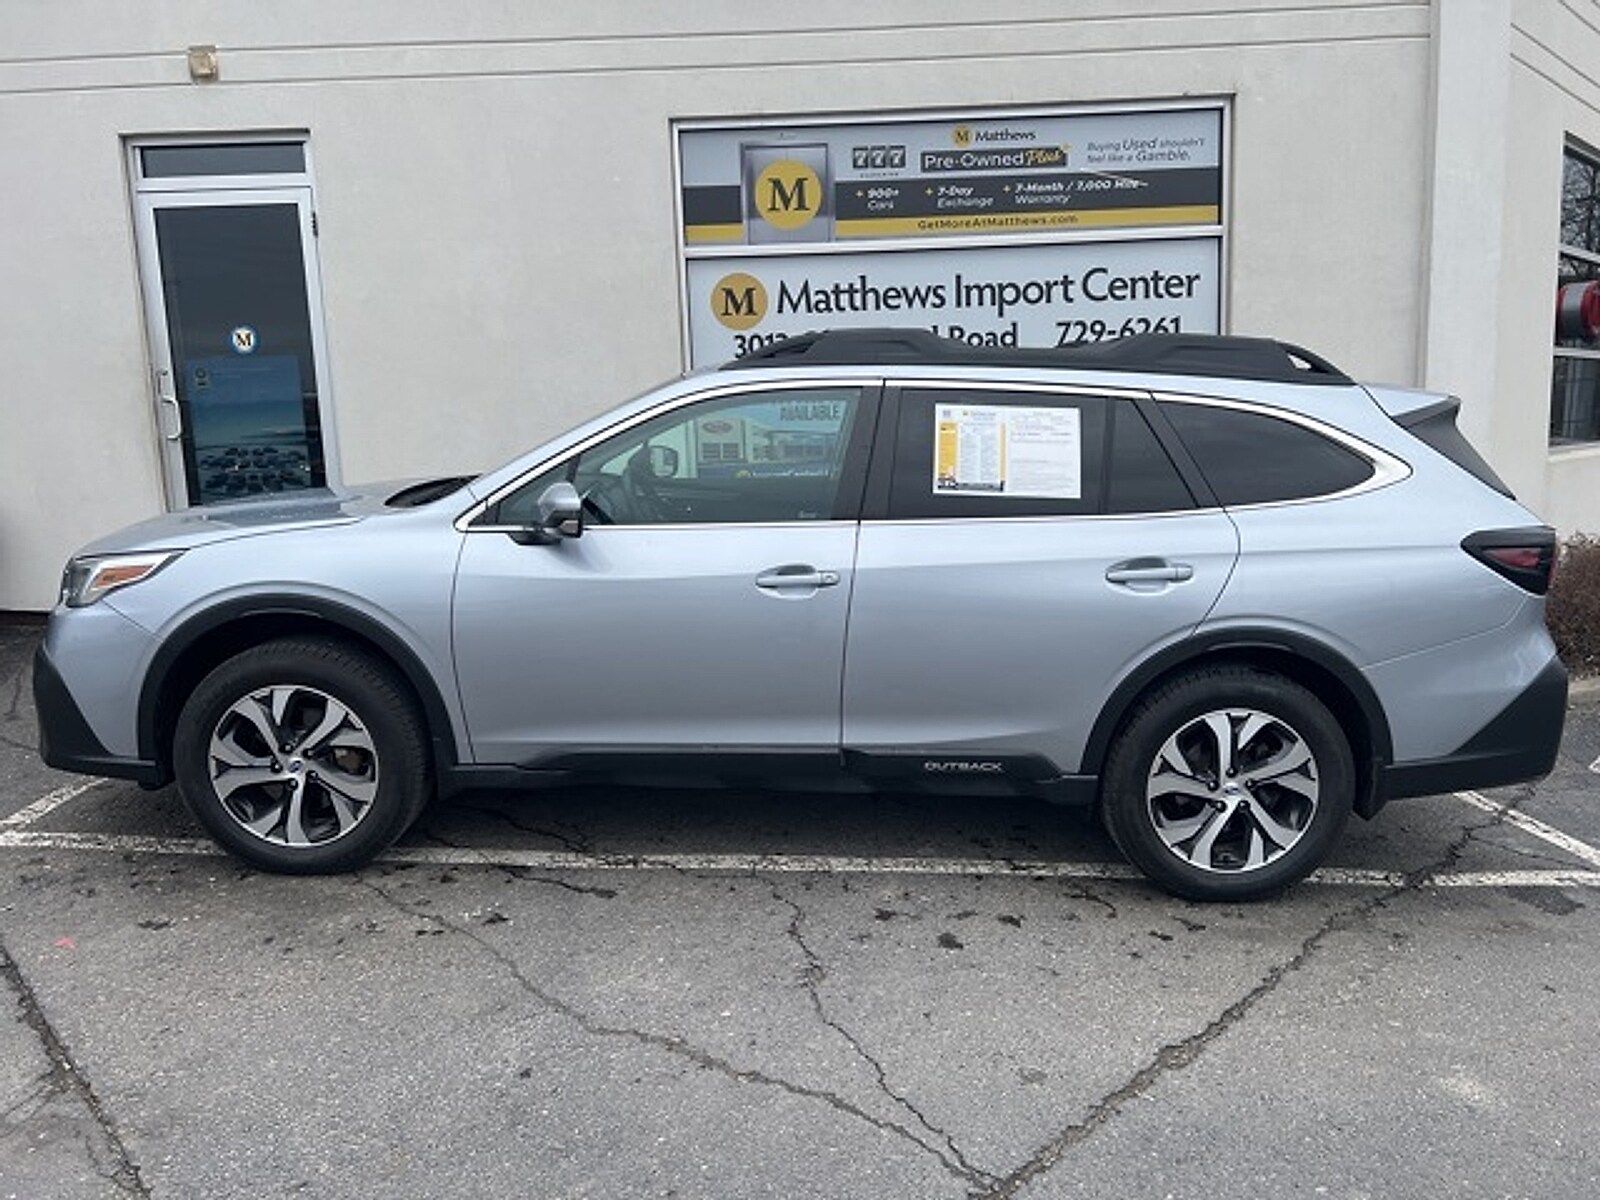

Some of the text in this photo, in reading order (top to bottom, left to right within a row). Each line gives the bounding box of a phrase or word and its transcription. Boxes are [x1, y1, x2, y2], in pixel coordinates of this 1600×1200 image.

[955, 128, 1036, 143] M Matthews
[1123, 138, 1158, 151] Used
[937, 186, 974, 197] 7-Day
[1015, 181, 1064, 193] 7-Month
[1077, 179, 1112, 191] 7,000
[767, 177, 811, 212] M
[1015, 193, 1071, 205] Warranty
[937, 196, 994, 210] Exchange
[917, 214, 1079, 230] GetMoreAtMatthews.com
[721, 267, 1200, 318] M Matthews Import Center
[923, 761, 1003, 772] OUTBACK
